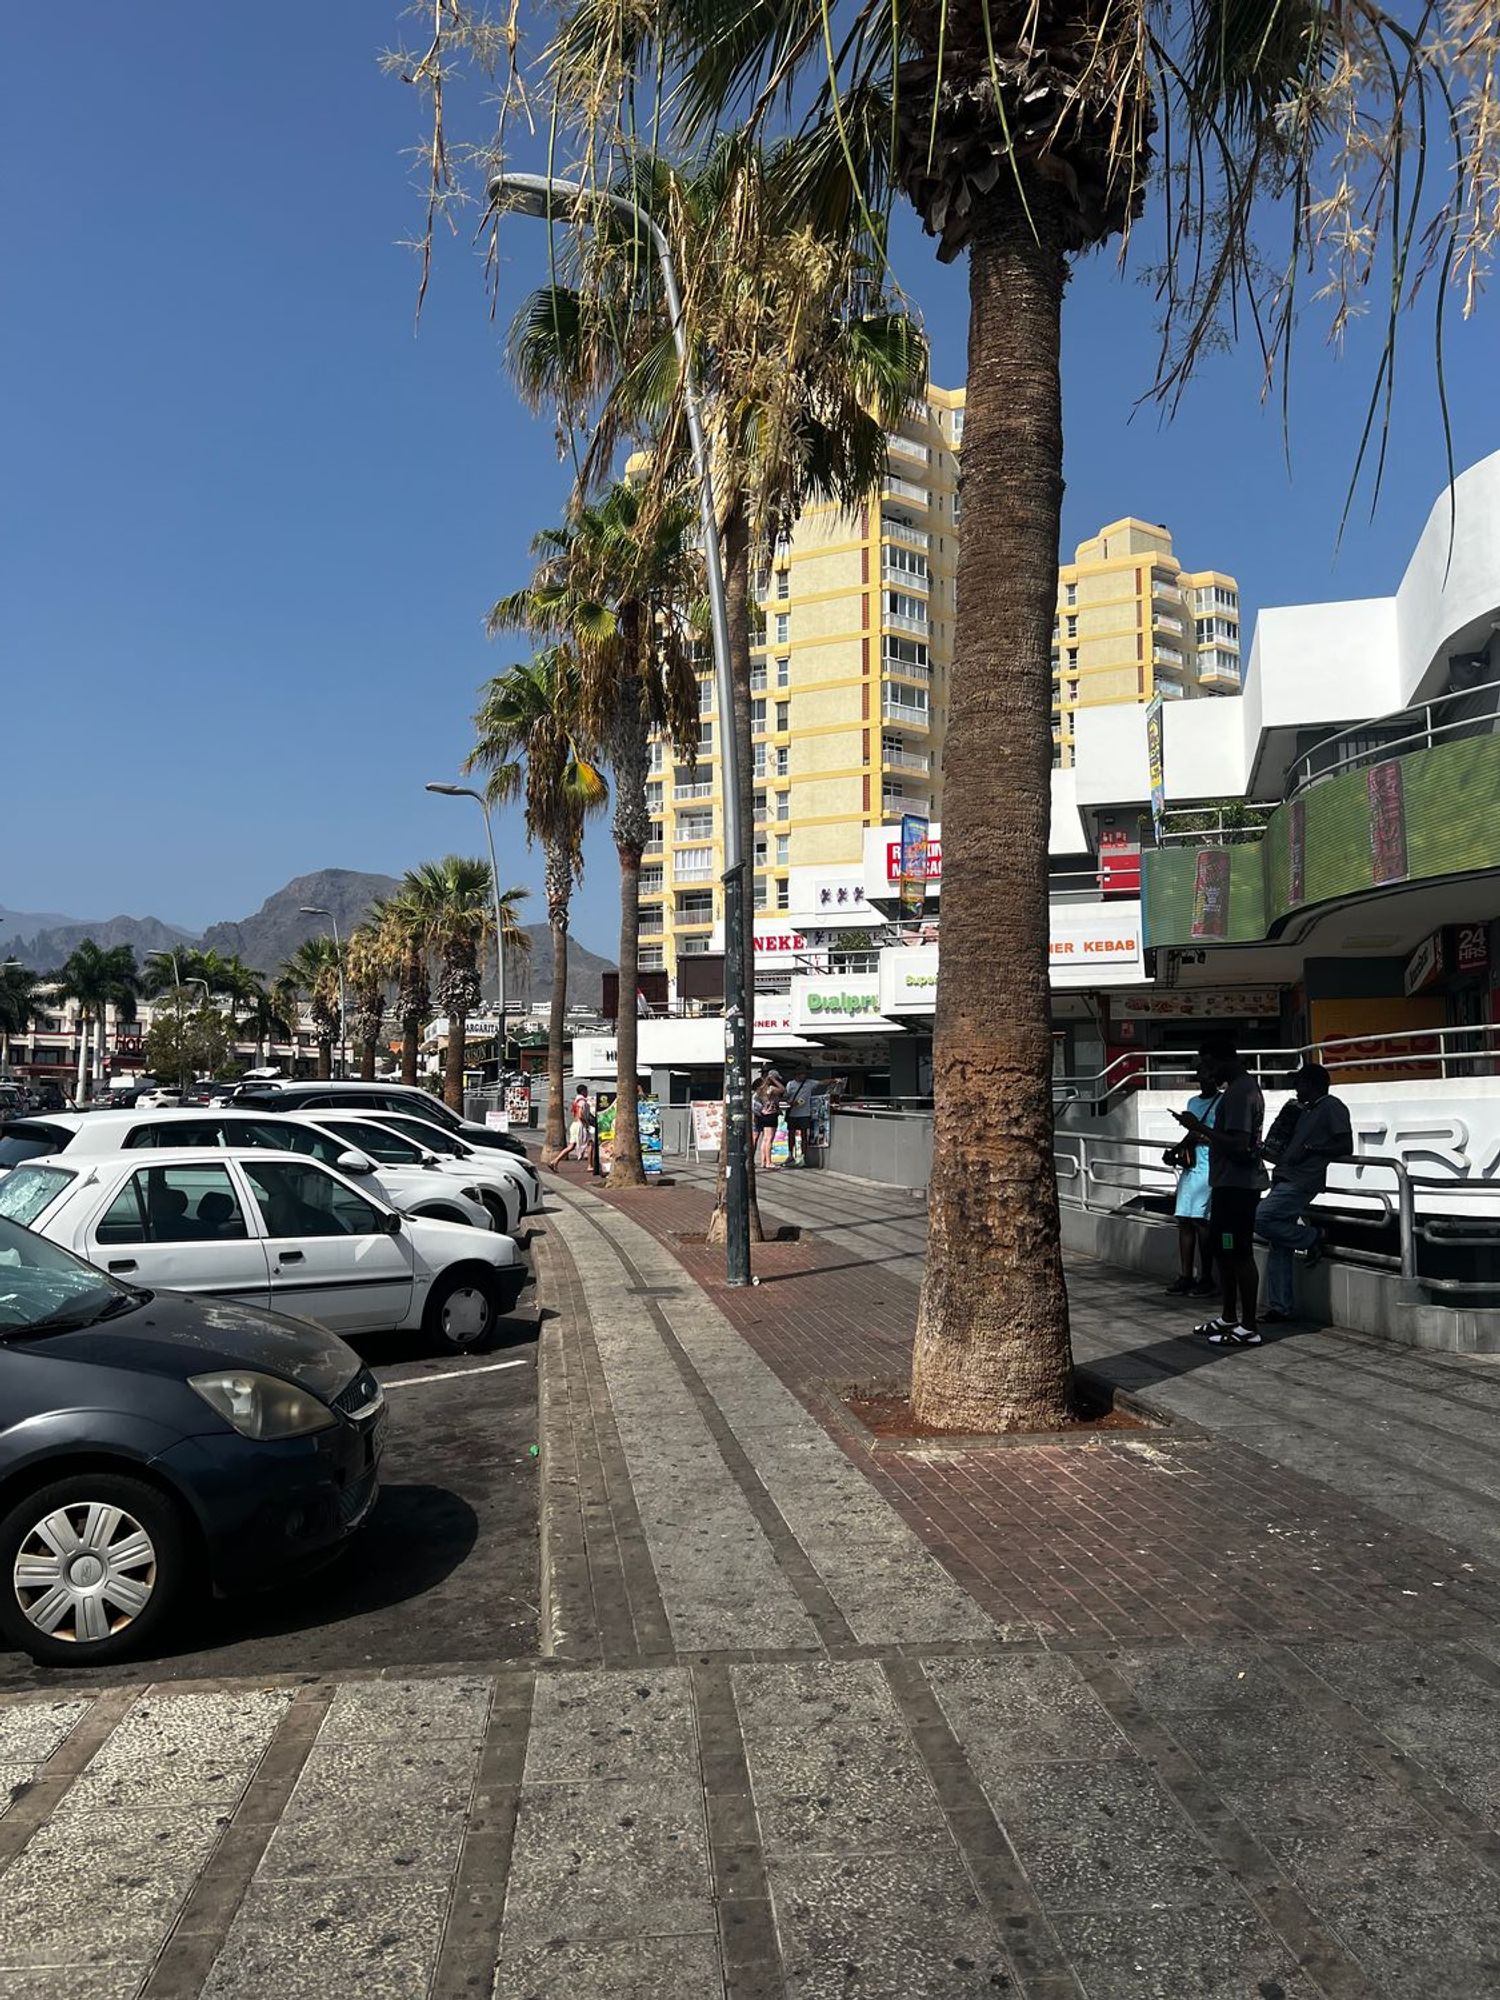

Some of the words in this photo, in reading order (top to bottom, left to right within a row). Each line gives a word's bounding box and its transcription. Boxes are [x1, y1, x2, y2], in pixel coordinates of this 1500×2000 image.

[1459, 927, 1486, 949] 24
[1084, 940, 1135, 952] KEBAB
[1458, 945, 1487, 960] HRS
[905, 975, 938, 988] Supe
